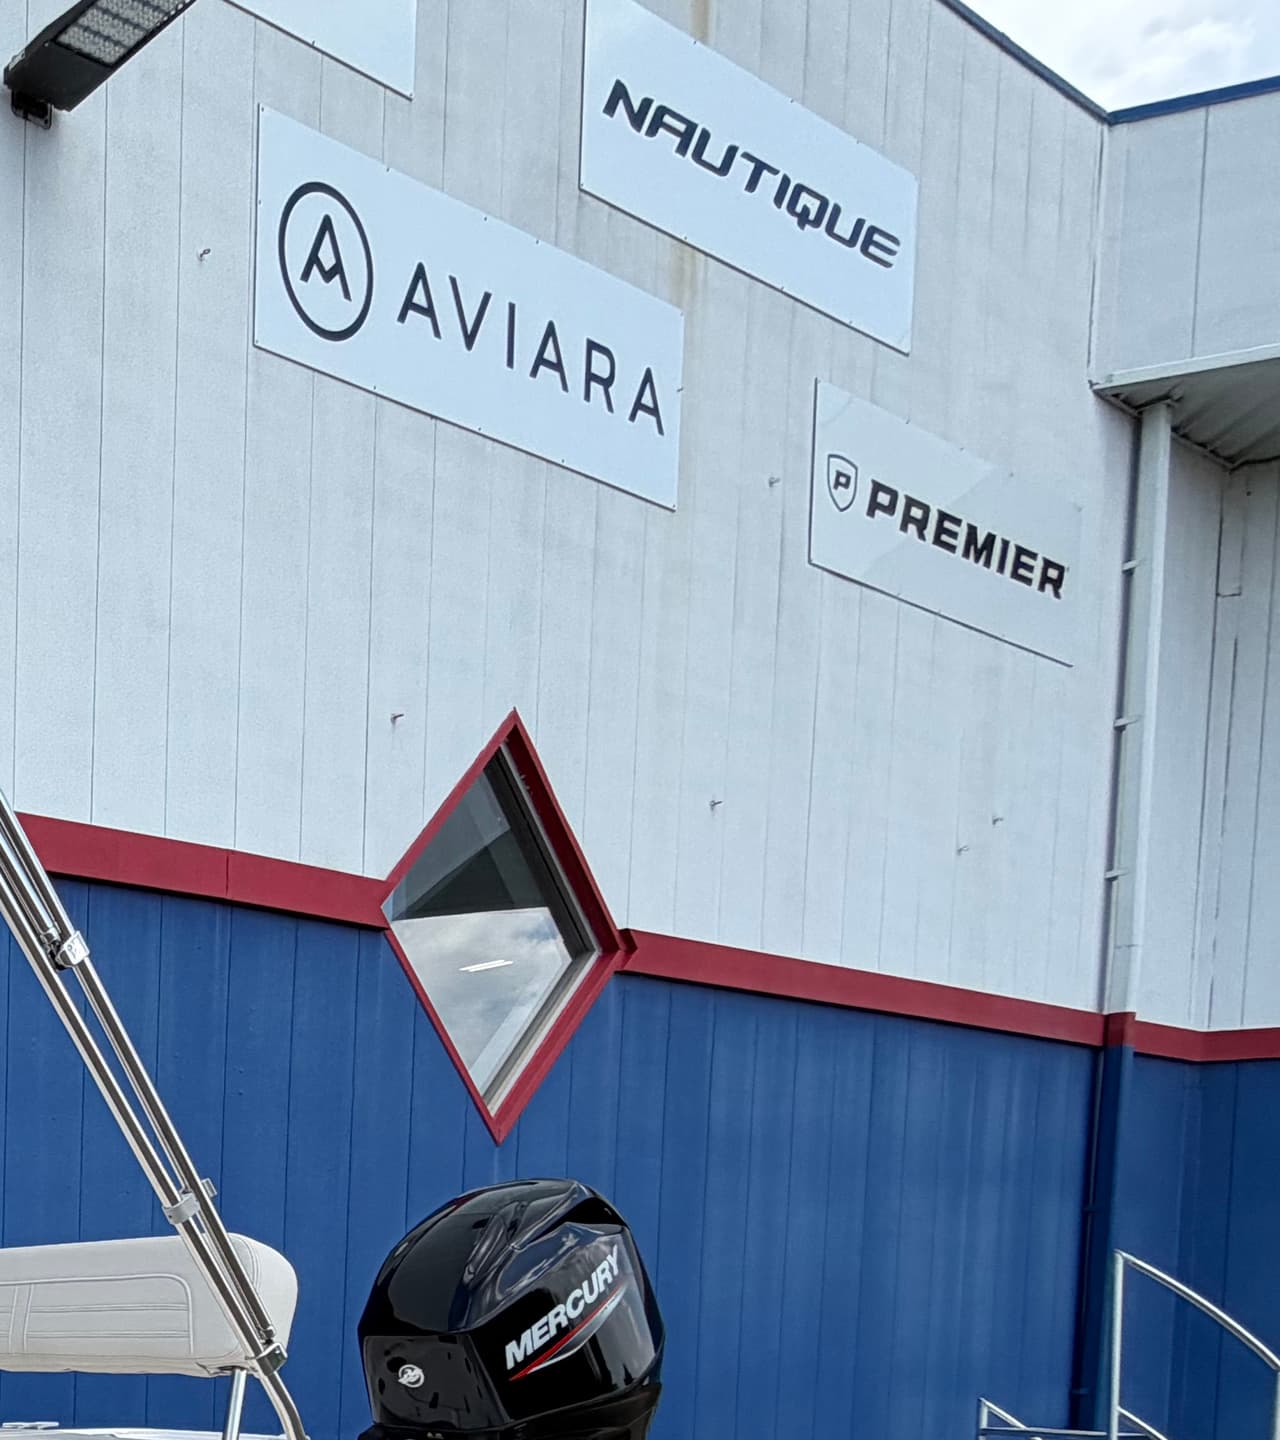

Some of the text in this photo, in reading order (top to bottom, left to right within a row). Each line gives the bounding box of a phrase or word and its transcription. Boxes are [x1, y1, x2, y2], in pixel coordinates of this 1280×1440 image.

[602, 78, 900, 269] NAUTIQUE
[397, 261, 664, 437] AVIARA
[866, 478, 1066, 600] PREMIER
[505, 1244, 619, 1370] MERCURY
